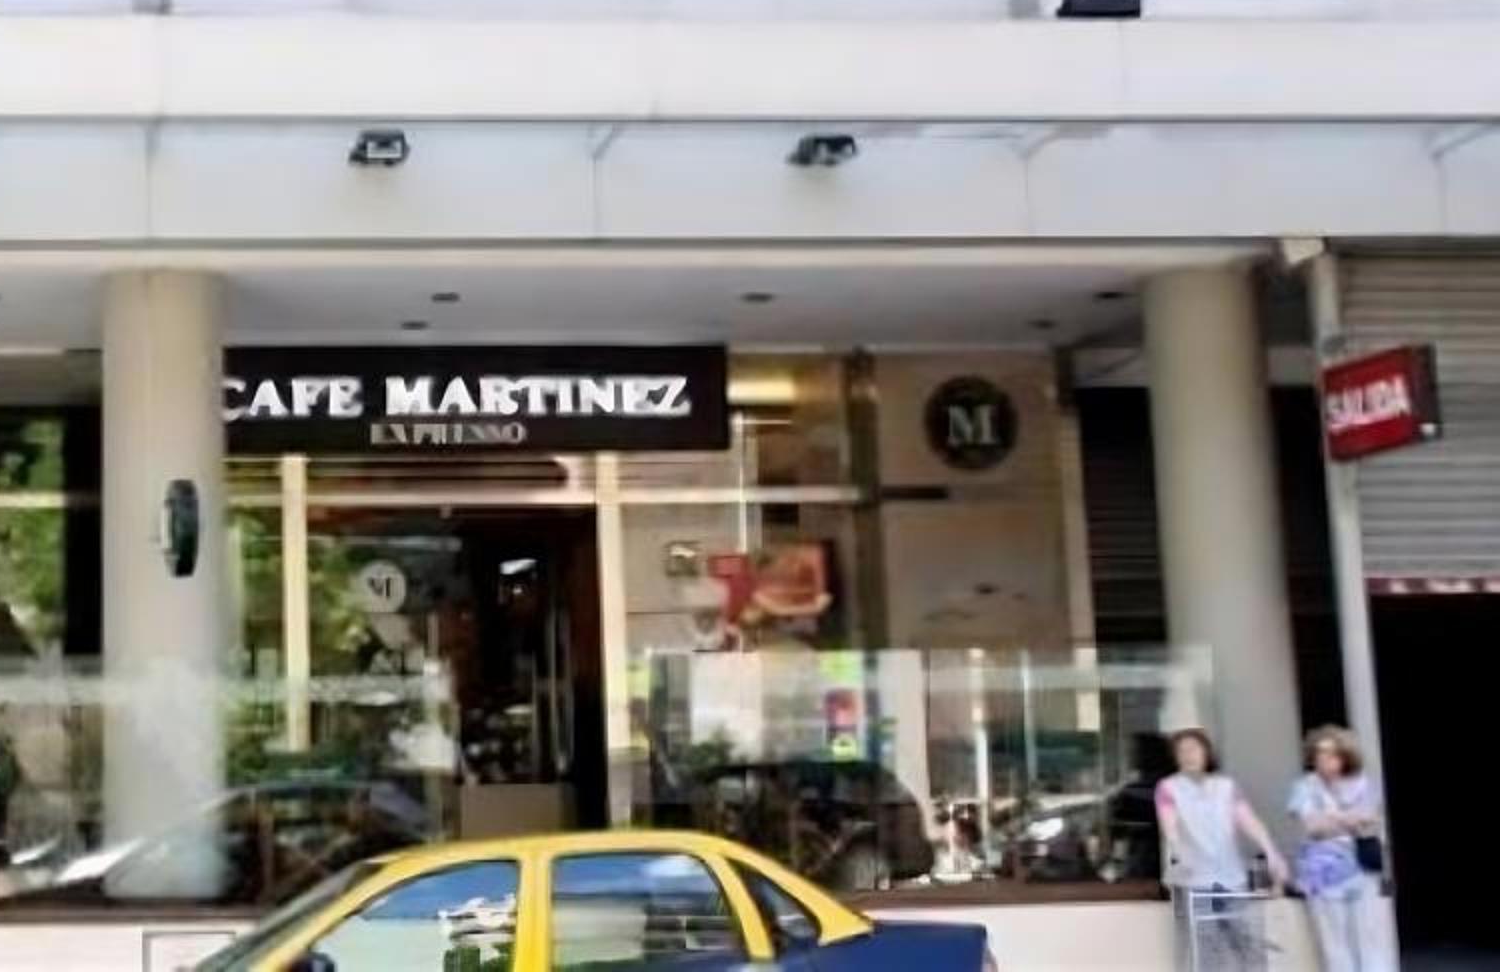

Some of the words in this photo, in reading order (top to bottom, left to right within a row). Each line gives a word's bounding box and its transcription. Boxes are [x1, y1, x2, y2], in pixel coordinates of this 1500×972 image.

[221, 376, 364, 422] CAFE
[384, 375, 692, 417] MARTINEZ
[1325, 374, 1411, 434] SALIDA
[947, 404, 998, 447] M
